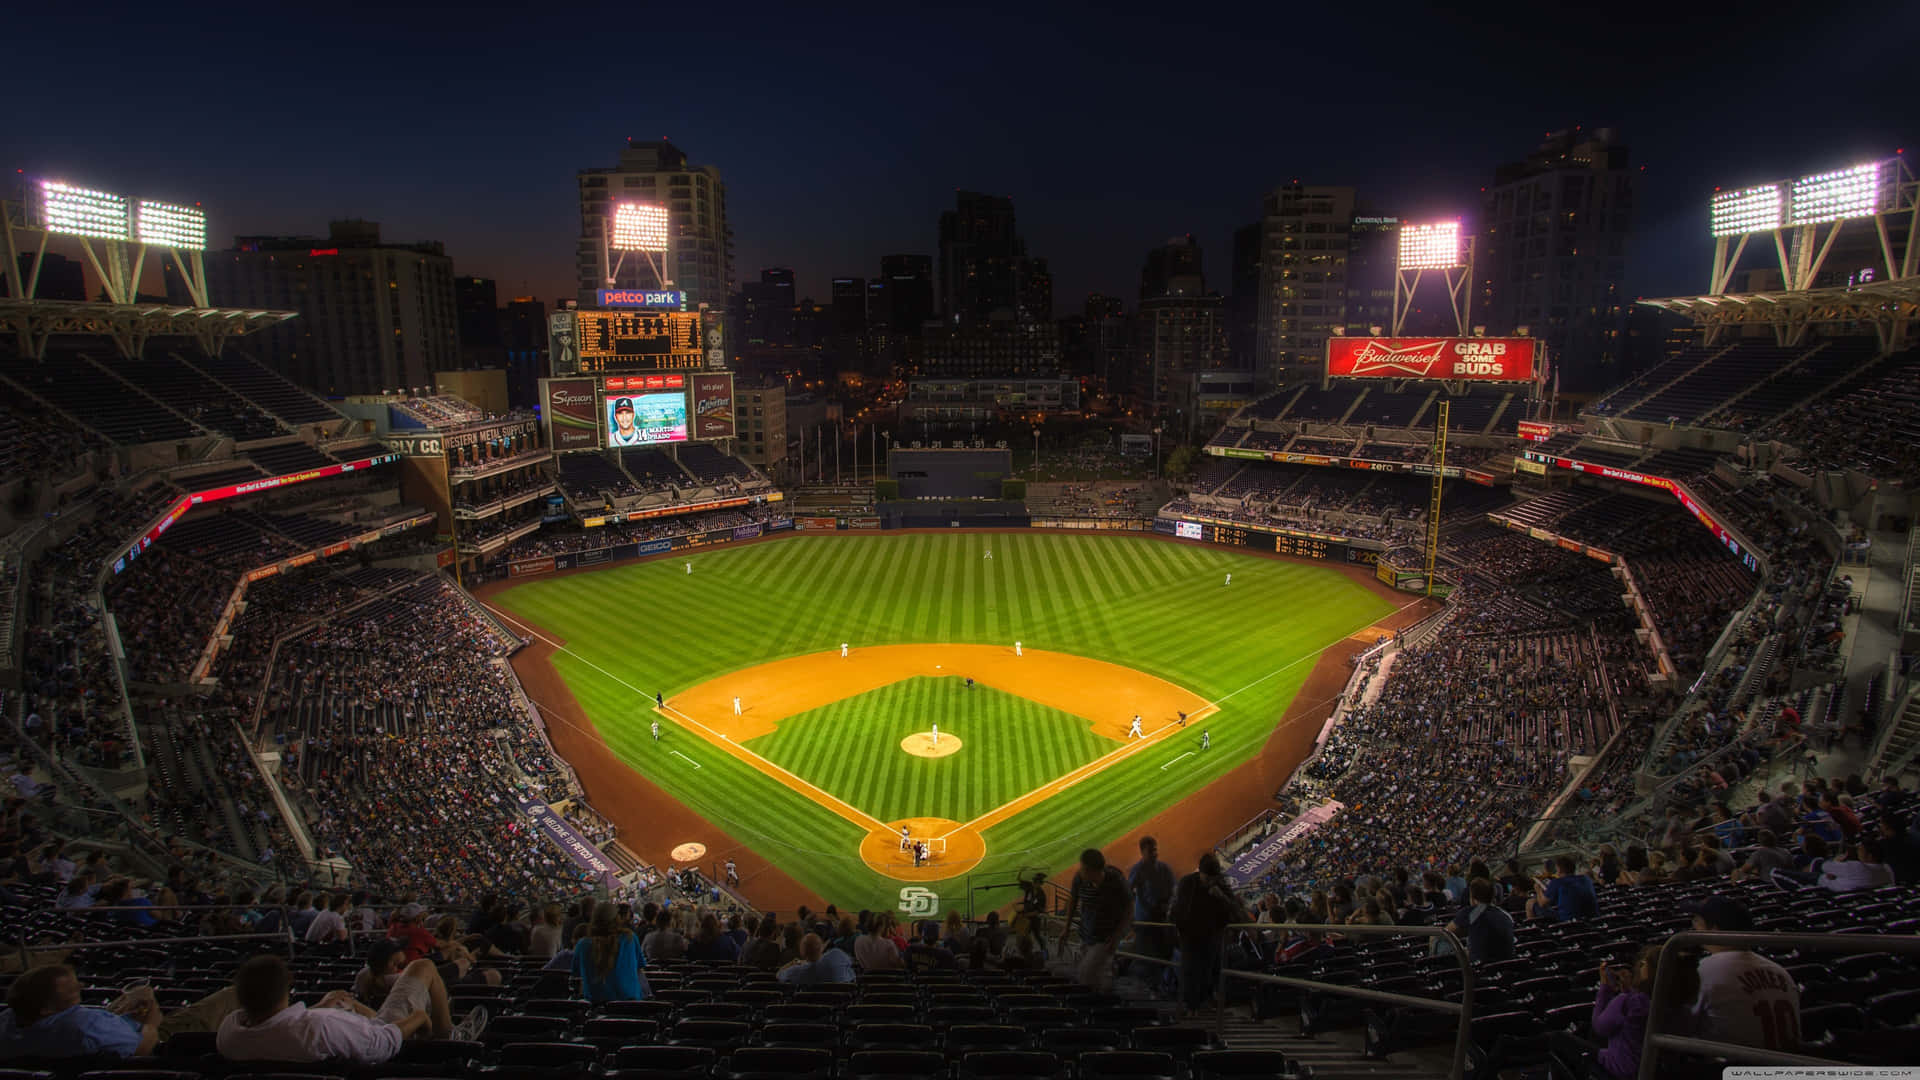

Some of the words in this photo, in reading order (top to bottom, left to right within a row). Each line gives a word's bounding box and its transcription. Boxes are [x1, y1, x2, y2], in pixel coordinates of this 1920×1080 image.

[605, 291, 644, 305] petco
[646, 290, 674, 306] park
[1354, 349, 1440, 364] Budweiser
[1454, 343, 1506, 355] GRAB
[1462, 354, 1496, 363] SOME
[1454, 363, 1504, 376] BUDS
[552, 390, 594, 406] Sycuan
[445, 433, 478, 449] WESTERN
[480, 428, 500, 442] METAL
[502, 423, 525, 438] SUPPLY
[638, 428, 648, 441] 14
[420, 439, 444, 454] CO.
[1370, 462, 1393, 472] zero
[640, 541, 672, 552] GEICO
[542, 816, 569, 838] WELCOME
[564, 835, 576, 844] TO
[570, 842, 592, 859] PETCO
[588, 857, 608, 872] PARK
[1238, 858, 1261, 874] SAN
[1256, 842, 1282, 861] DIEGO
[1277, 821, 1310, 845] PADRES
[898, 886, 940, 918] SD
